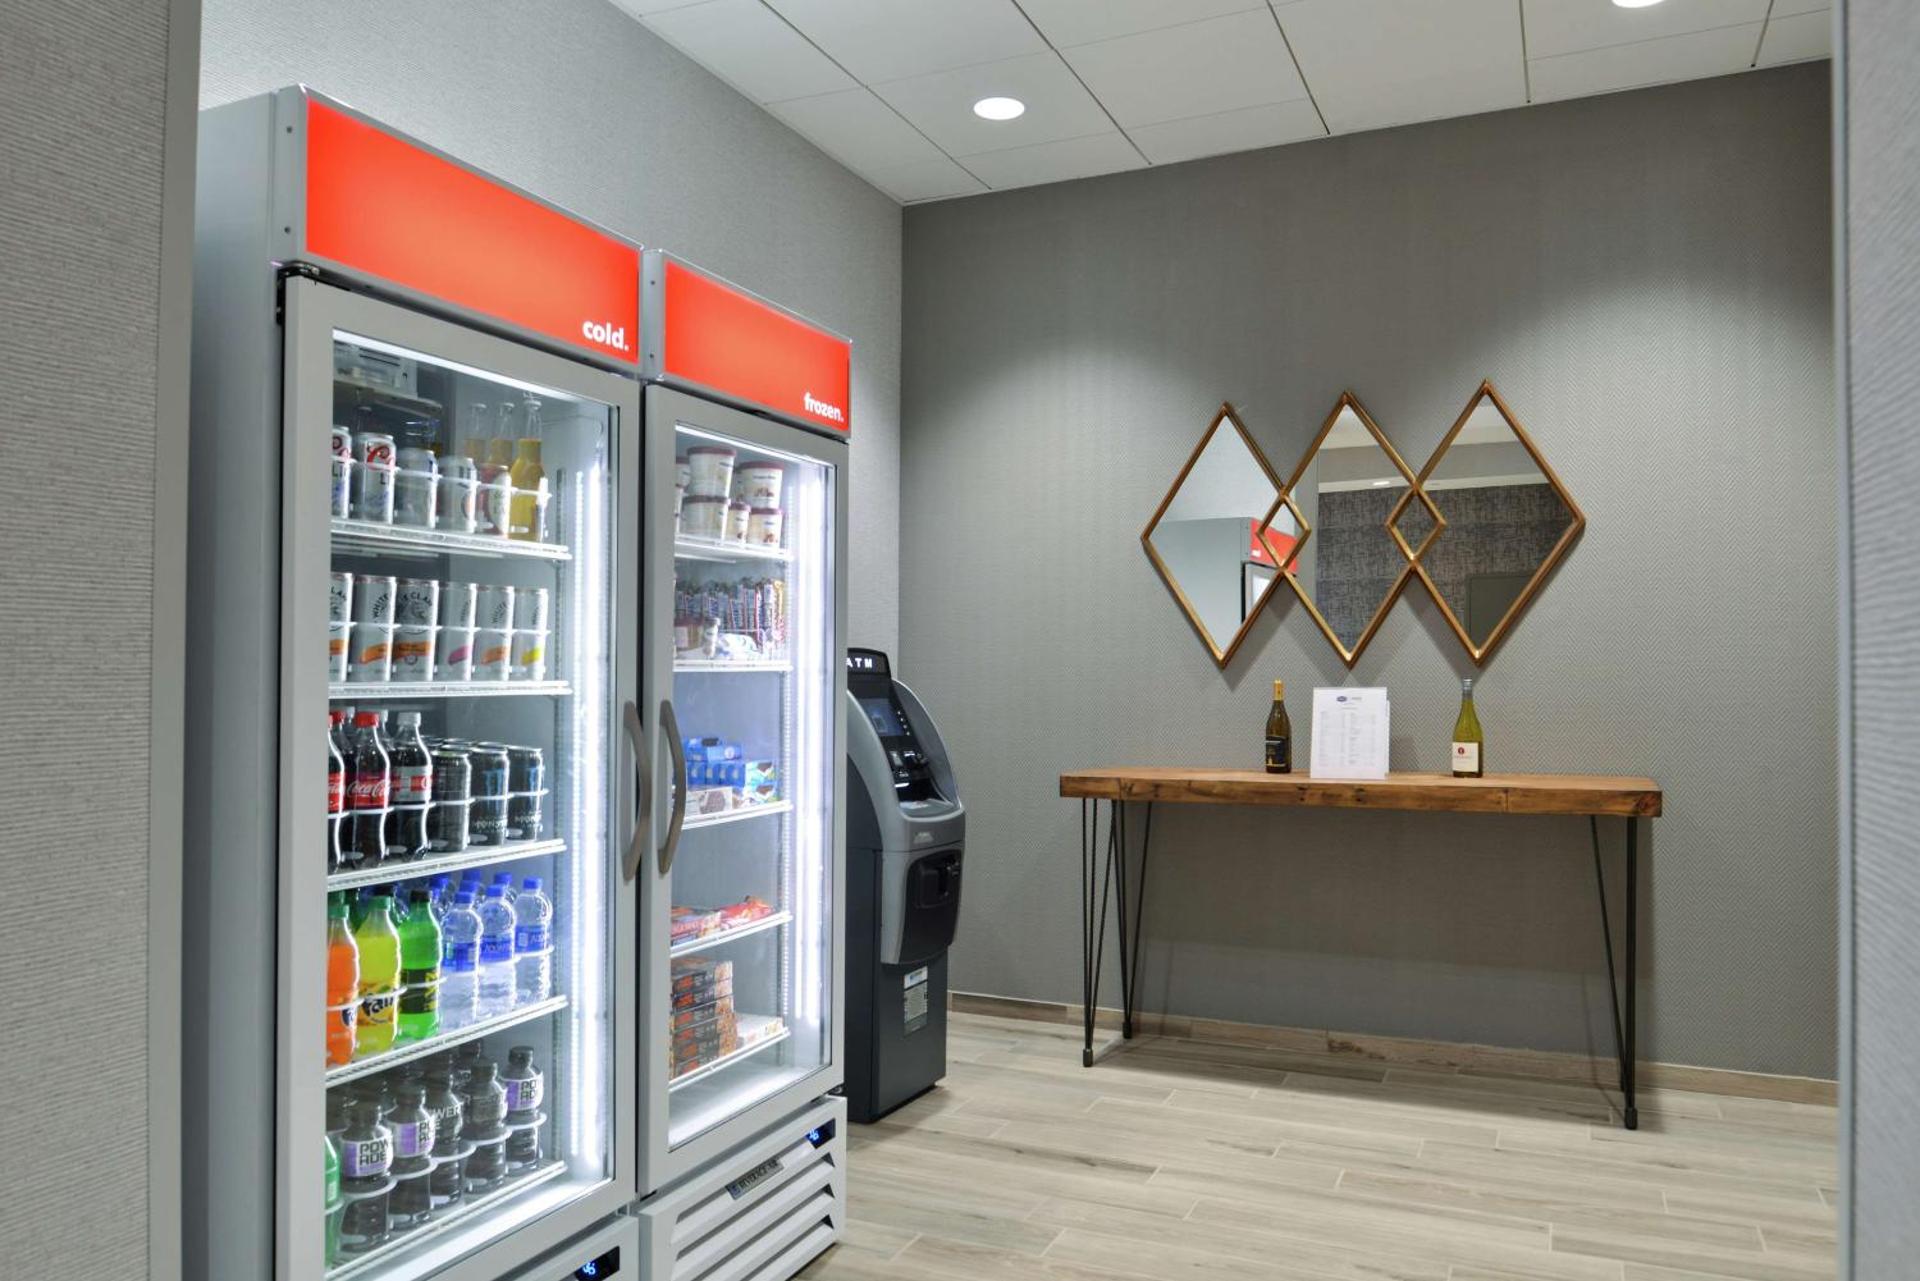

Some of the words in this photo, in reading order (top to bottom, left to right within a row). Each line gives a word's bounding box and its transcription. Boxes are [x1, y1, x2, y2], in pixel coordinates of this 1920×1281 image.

[582, 320, 629, 351] cold.
[804, 393, 844, 421] frozen.
[846, 657, 873, 668] ATM
